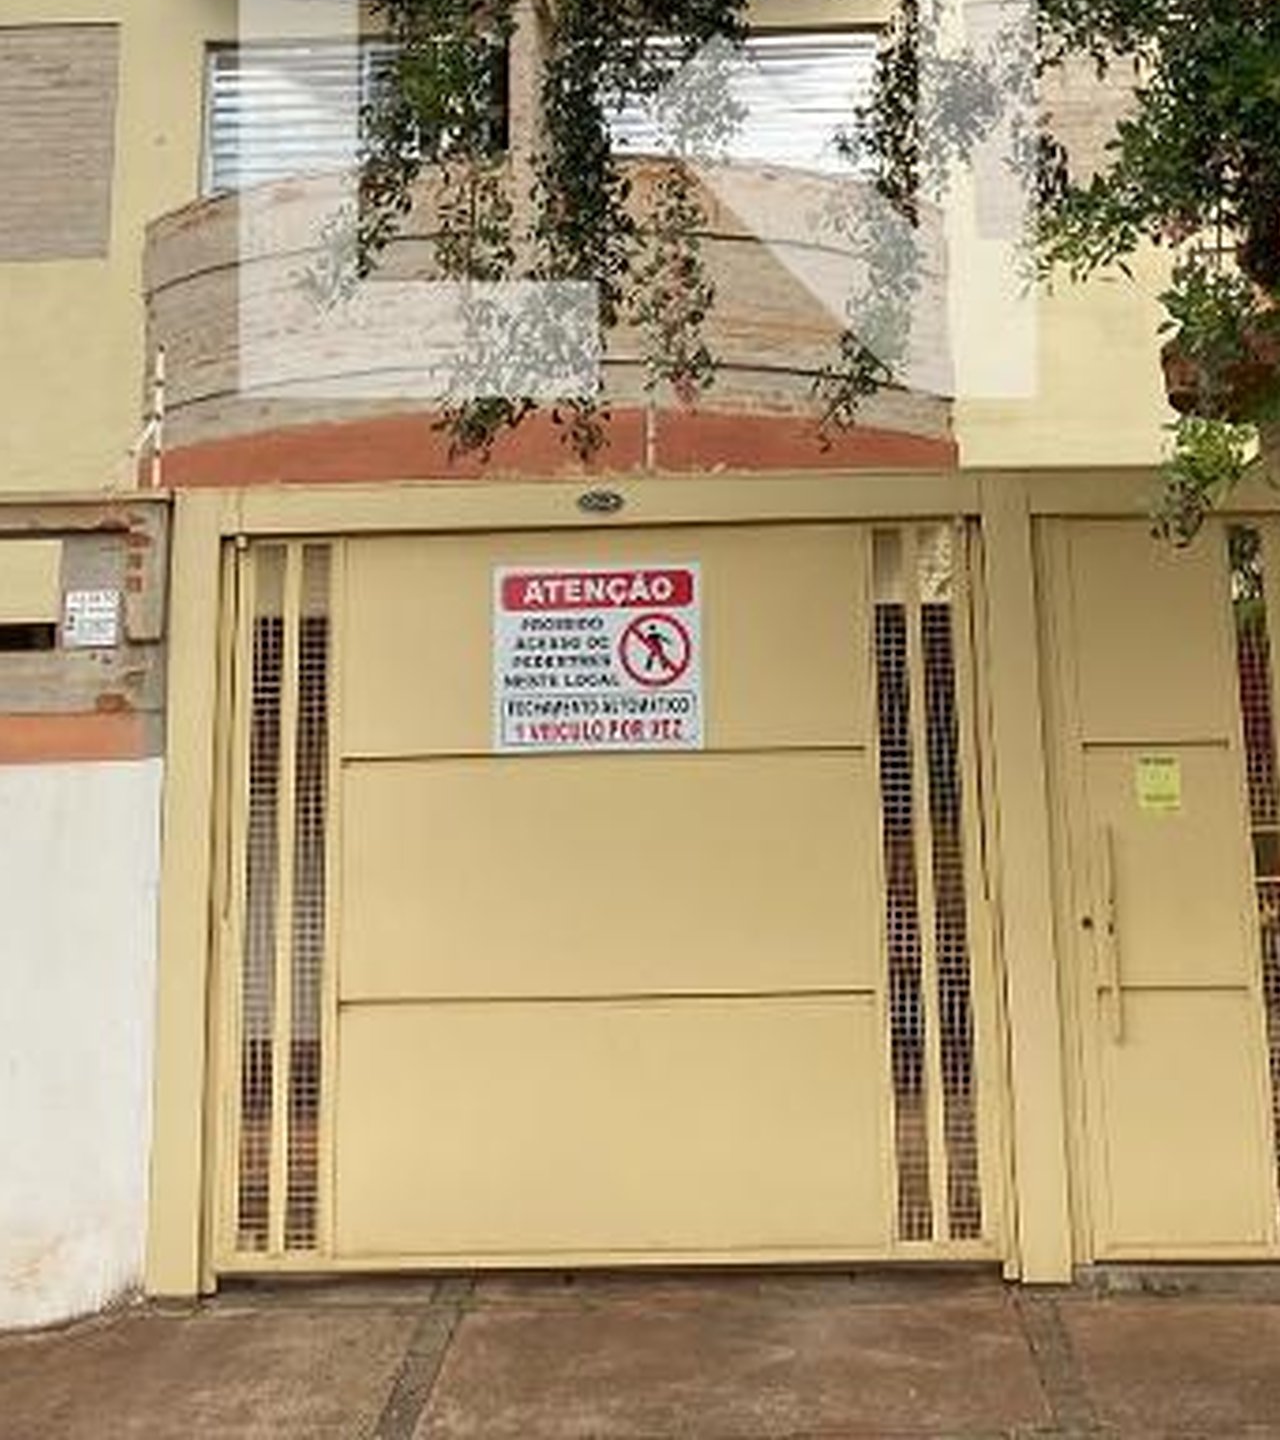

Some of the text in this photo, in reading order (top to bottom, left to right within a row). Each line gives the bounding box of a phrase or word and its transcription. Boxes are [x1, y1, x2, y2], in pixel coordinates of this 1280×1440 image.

[523, 572, 674, 603] ATENÇÃO
[516, 636, 581, 650] ACESSO
[504, 673, 620, 689] NESTE LOCAL
[610, 719, 642, 740] POR
[652, 718, 683, 740] VEZ
